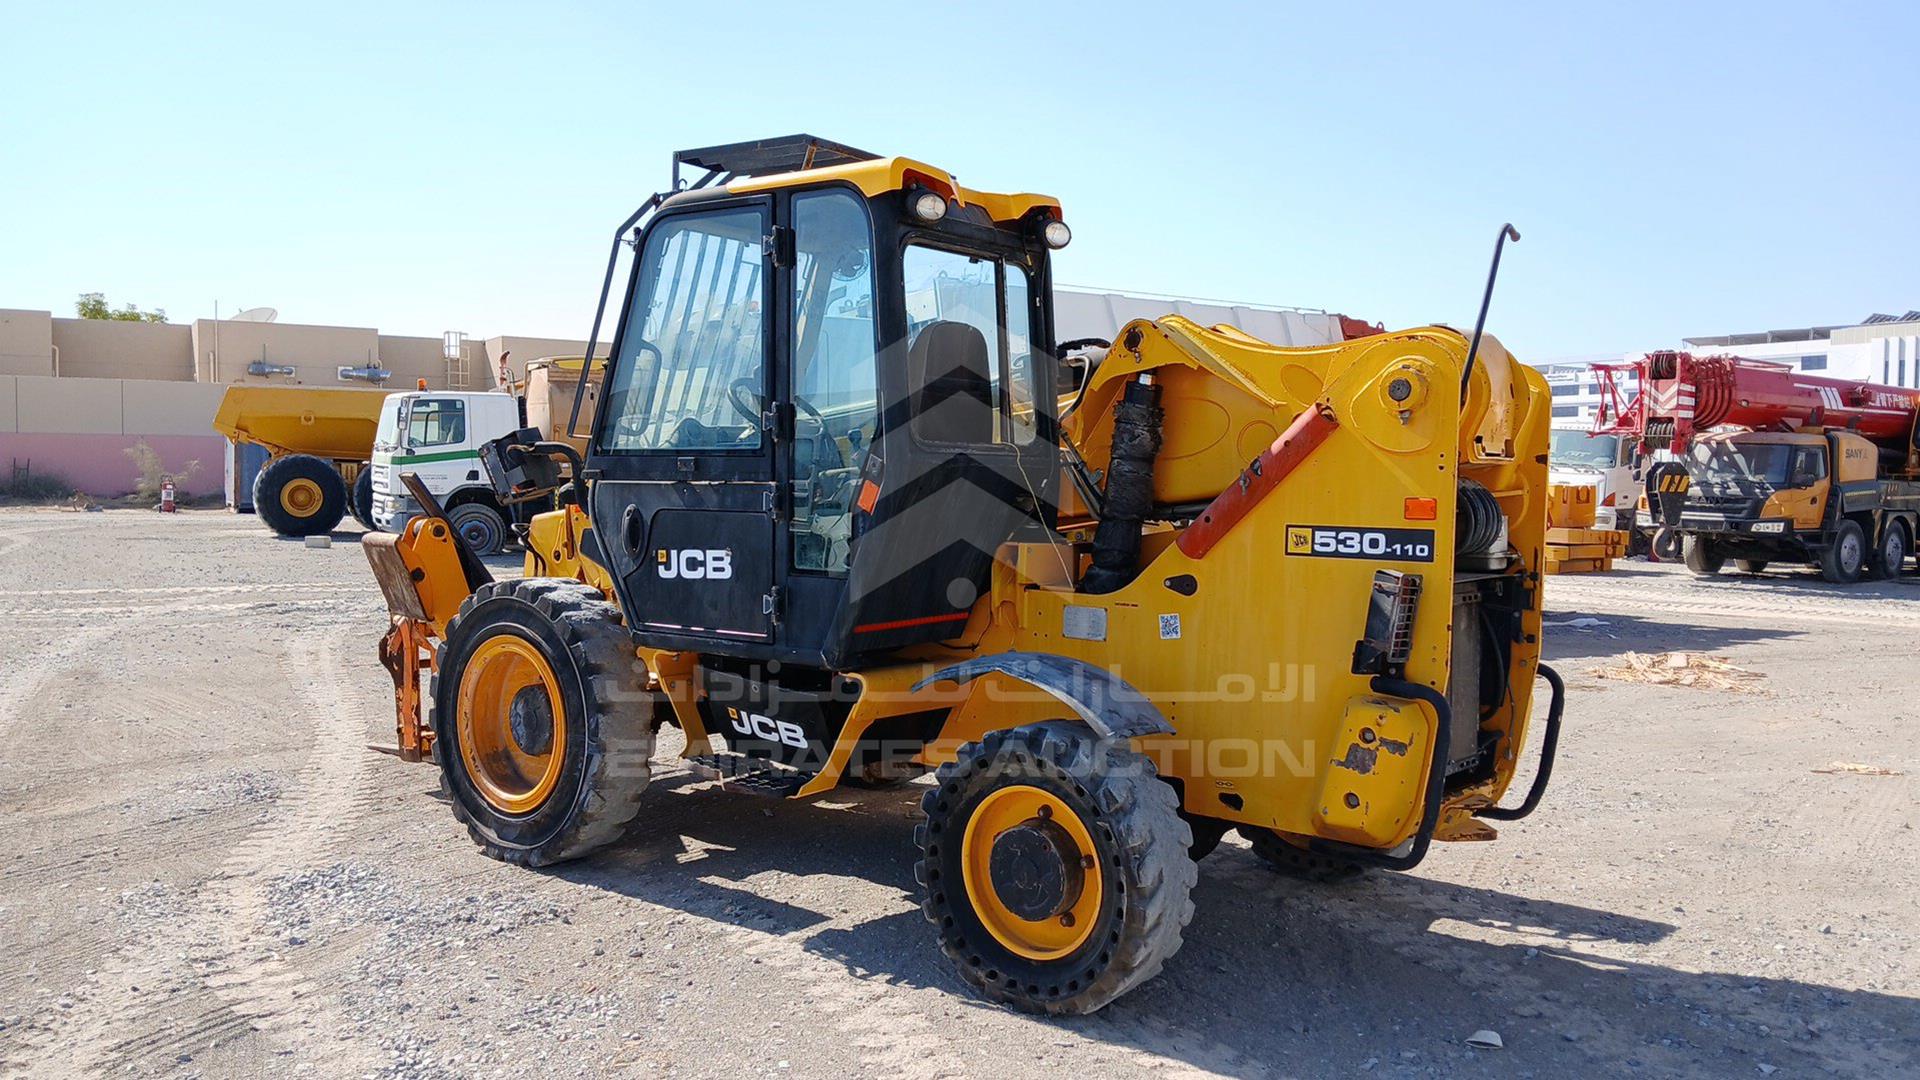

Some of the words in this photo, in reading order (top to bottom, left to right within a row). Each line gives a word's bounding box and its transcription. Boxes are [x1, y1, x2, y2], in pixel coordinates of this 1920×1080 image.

[1845, 448, 1863, 459] SANY
[1291, 532, 1309, 547] JCB
[1313, 530, 1429, 556] 530-110
[658, 549, 732, 579] JCB
[728, 707, 808, 749] JCB
